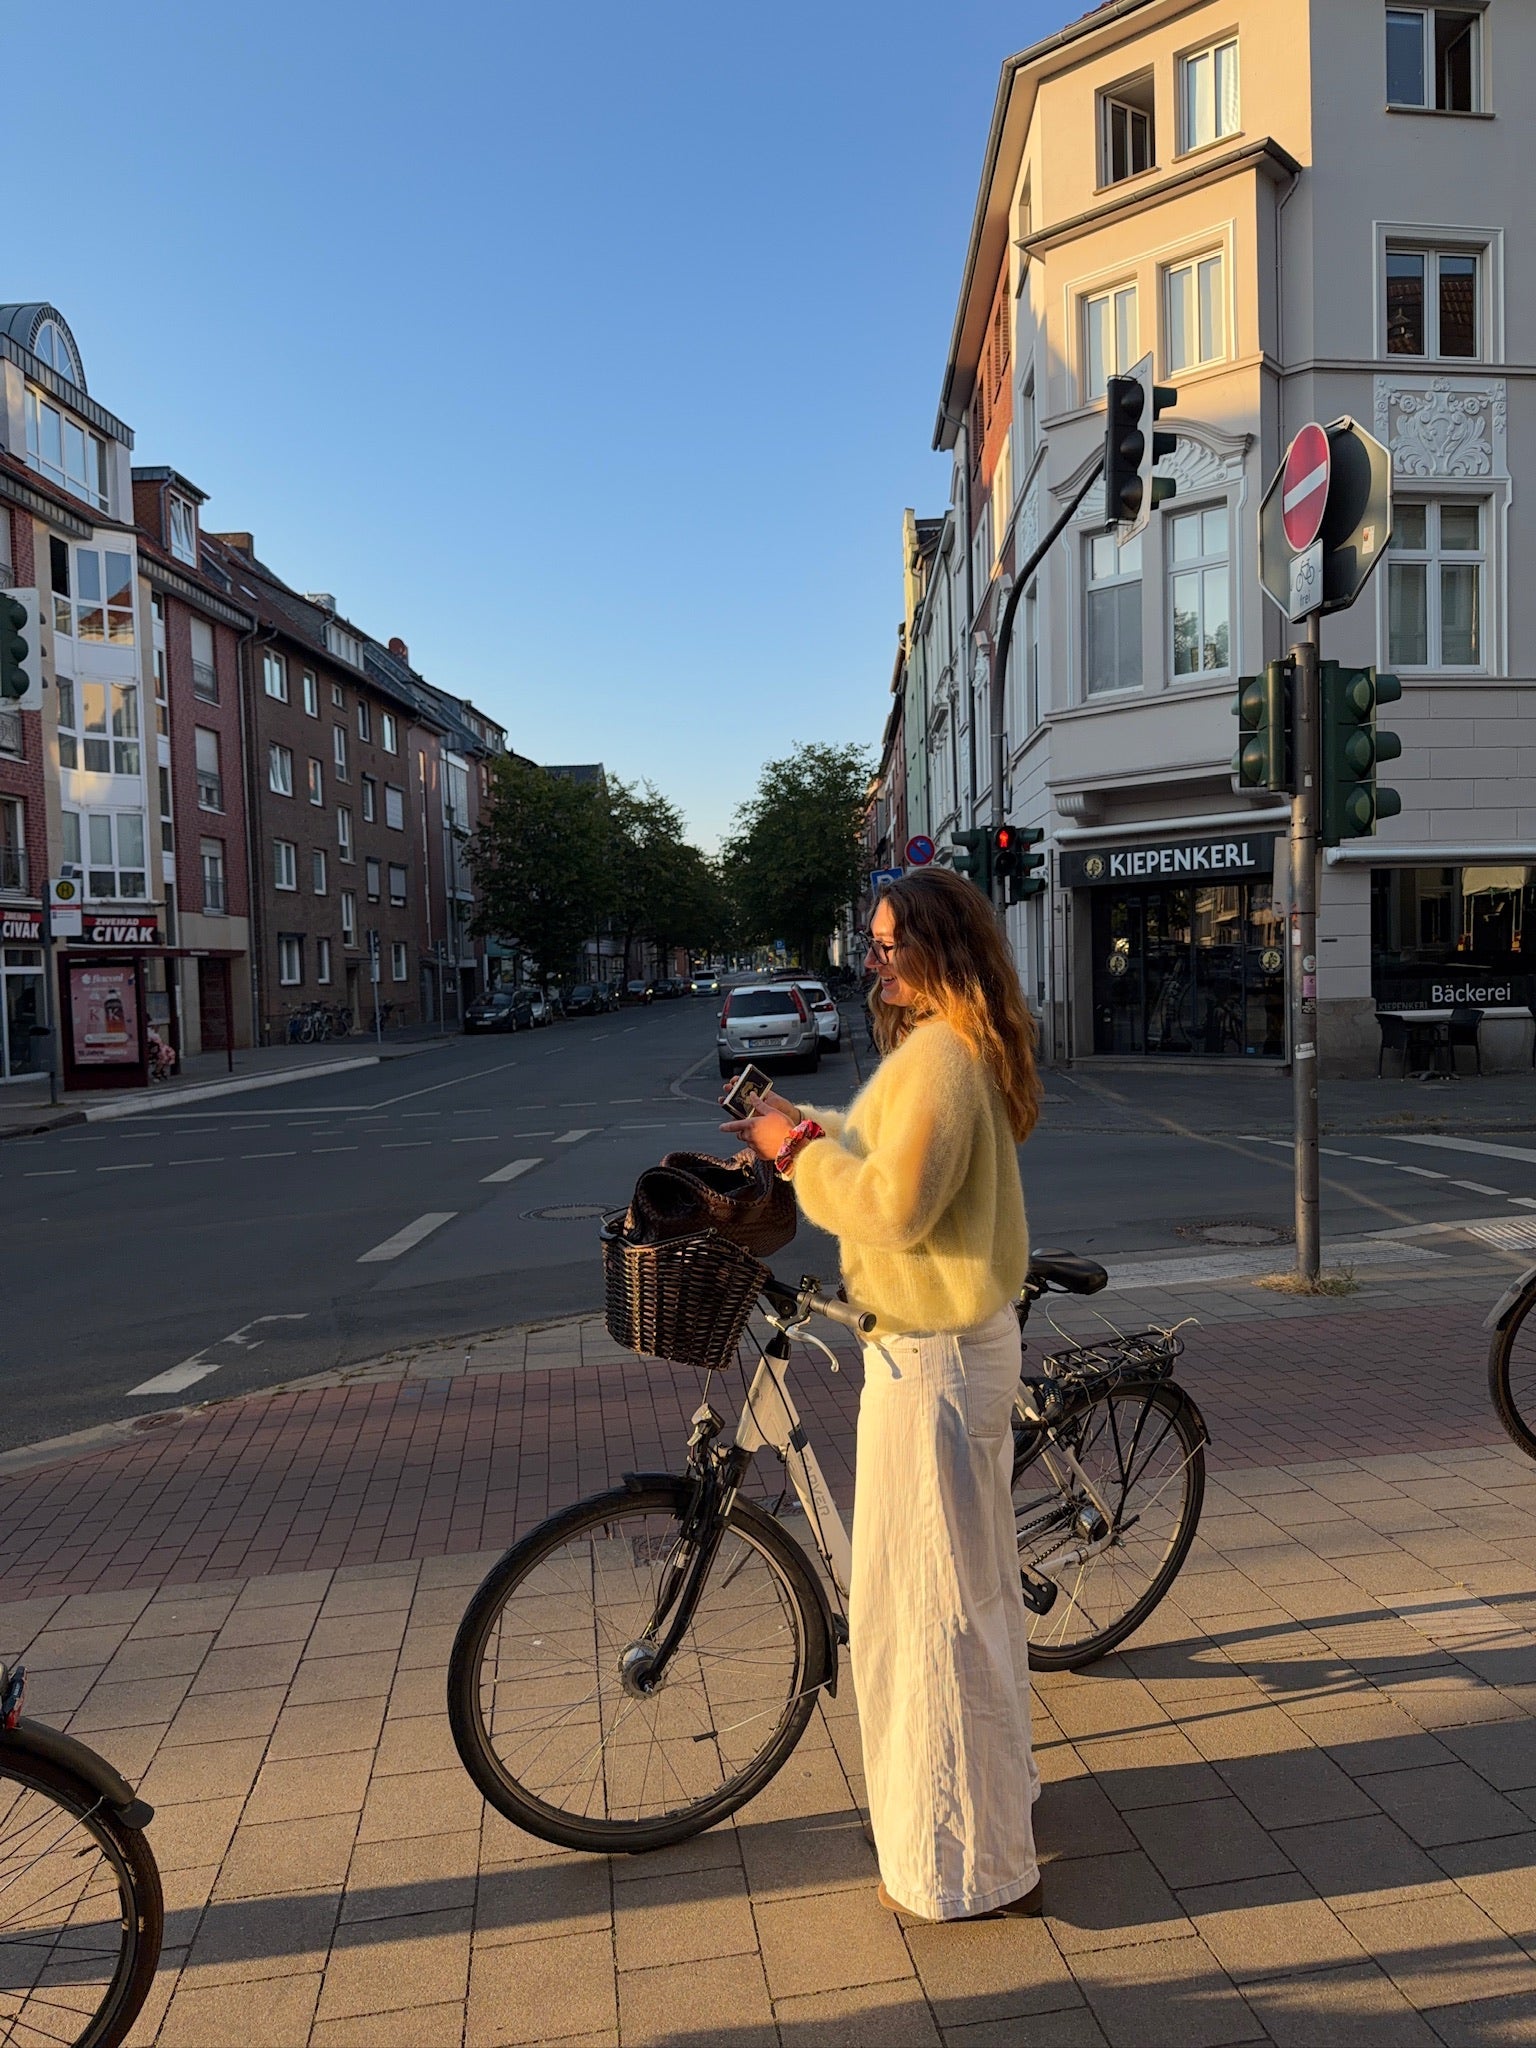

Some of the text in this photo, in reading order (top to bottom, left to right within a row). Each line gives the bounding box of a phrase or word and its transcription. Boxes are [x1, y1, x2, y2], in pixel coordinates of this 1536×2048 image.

[1300, 590, 1311, 607] frei
[1110, 843, 1255, 876] KIEPENKERL
[3, 921, 40, 939] CIVAK
[95, 917, 139, 926] ZWEIRAD
[92, 926, 155, 943] CIVAK
[1431, 982, 1512, 1003] Bäckerei
